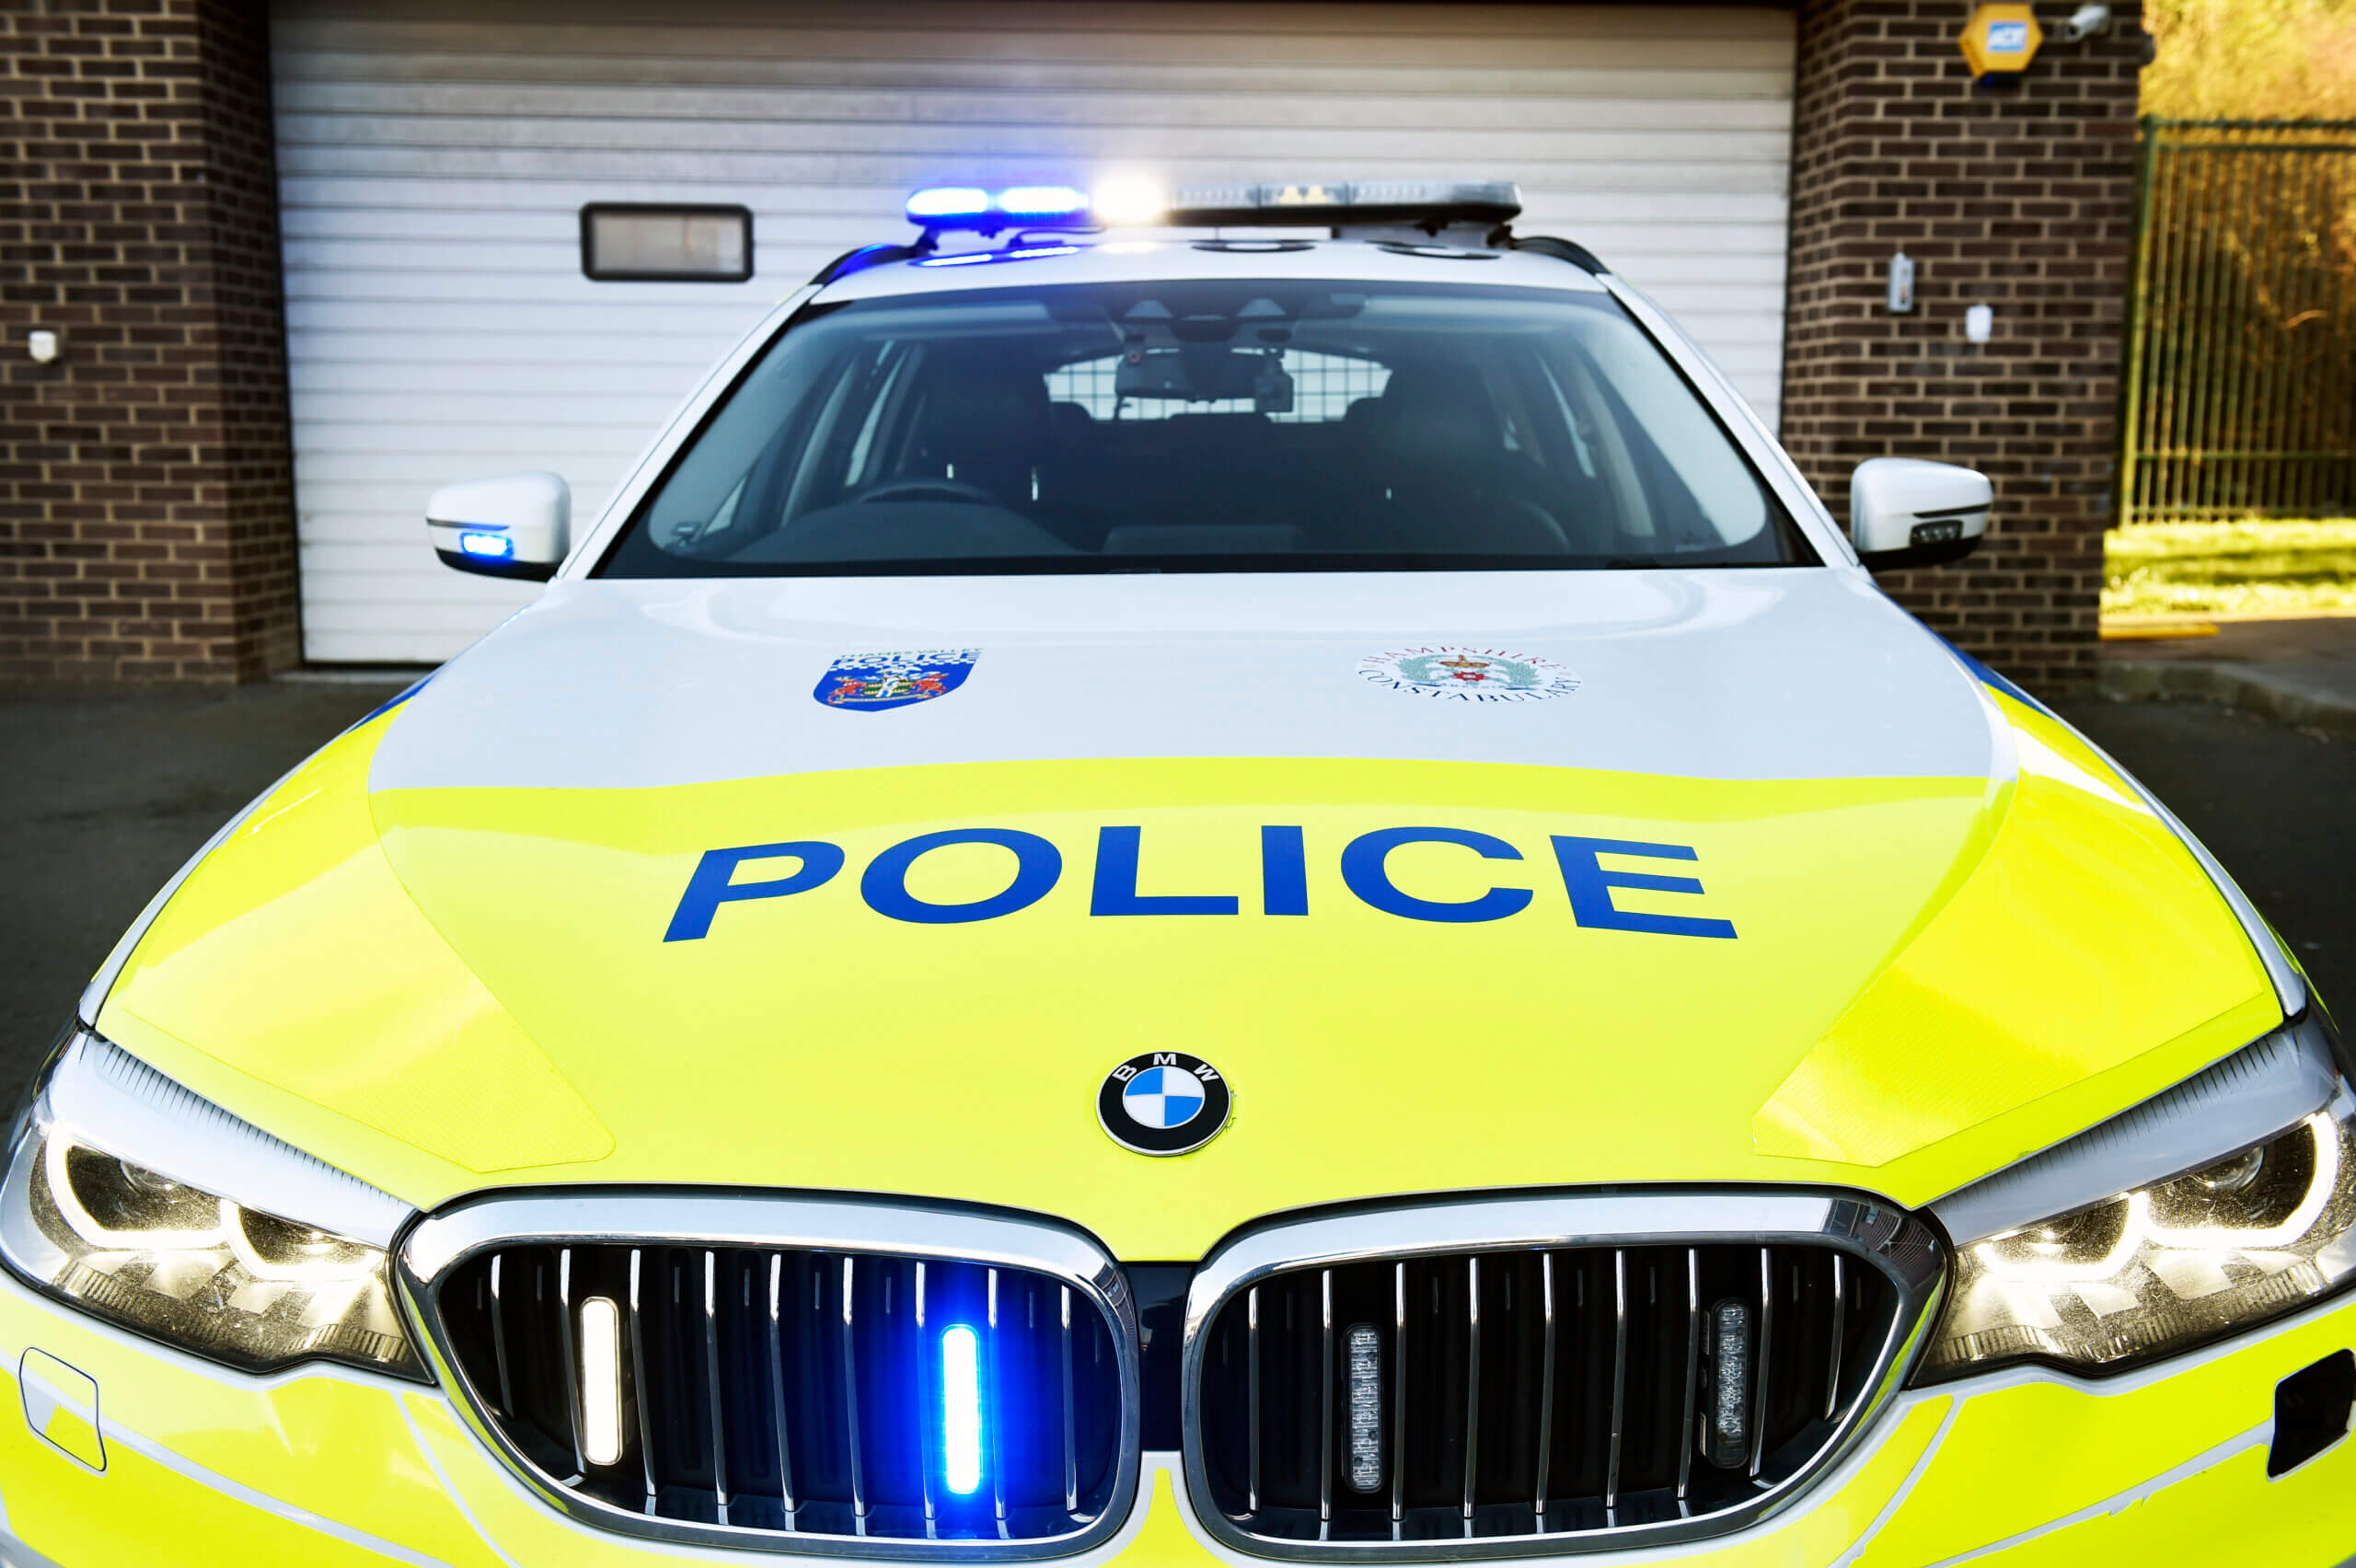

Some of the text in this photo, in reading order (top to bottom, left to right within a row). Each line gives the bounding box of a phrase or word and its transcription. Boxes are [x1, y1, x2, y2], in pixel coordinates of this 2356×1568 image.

[832, 651, 981, 666] POLICE
[1361, 646, 1568, 671] HAMPSHIRE
[1358, 669, 1582, 702] CONSTABULARY
[664, 826, 1737, 941] POLICE
[1112, 1053, 1219, 1082] BMW
